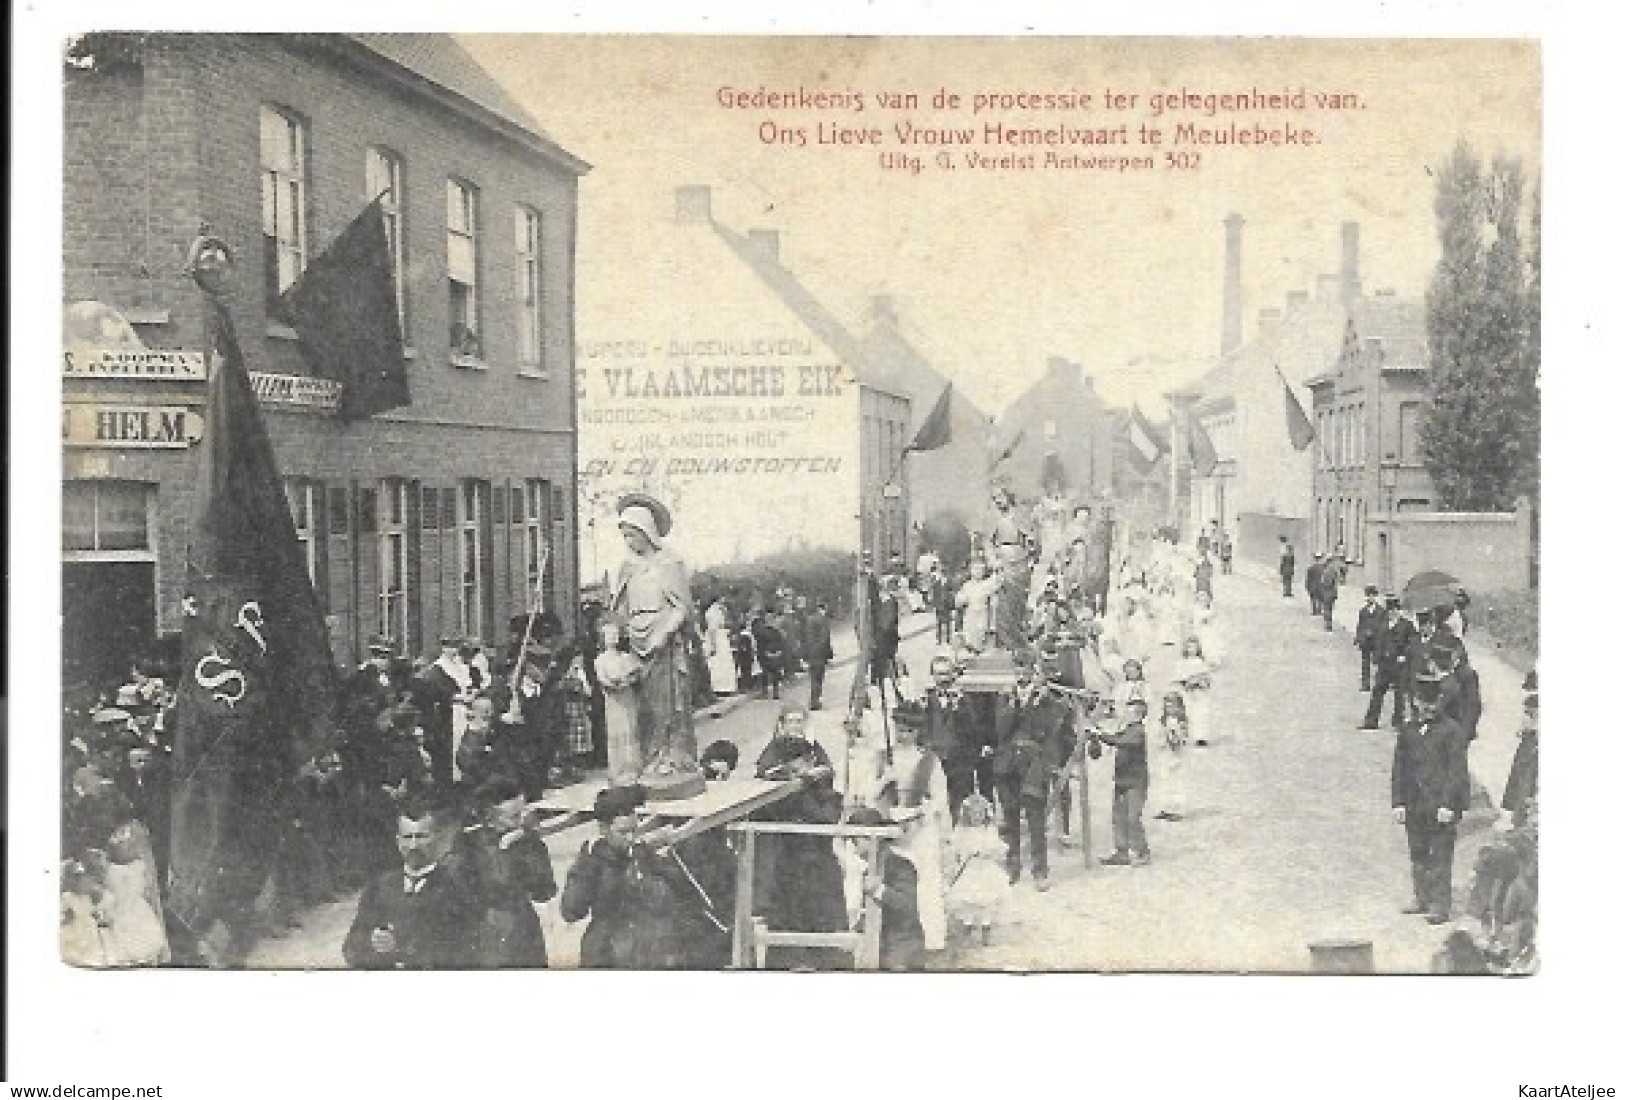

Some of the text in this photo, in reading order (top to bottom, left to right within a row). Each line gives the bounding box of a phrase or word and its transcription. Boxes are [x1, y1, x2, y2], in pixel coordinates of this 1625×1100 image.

[604, 366, 785, 397] VLAAMSCHE
[797, 366, 842, 396] EIK
[664, 457, 842, 474] BOUWSTOFFEN
